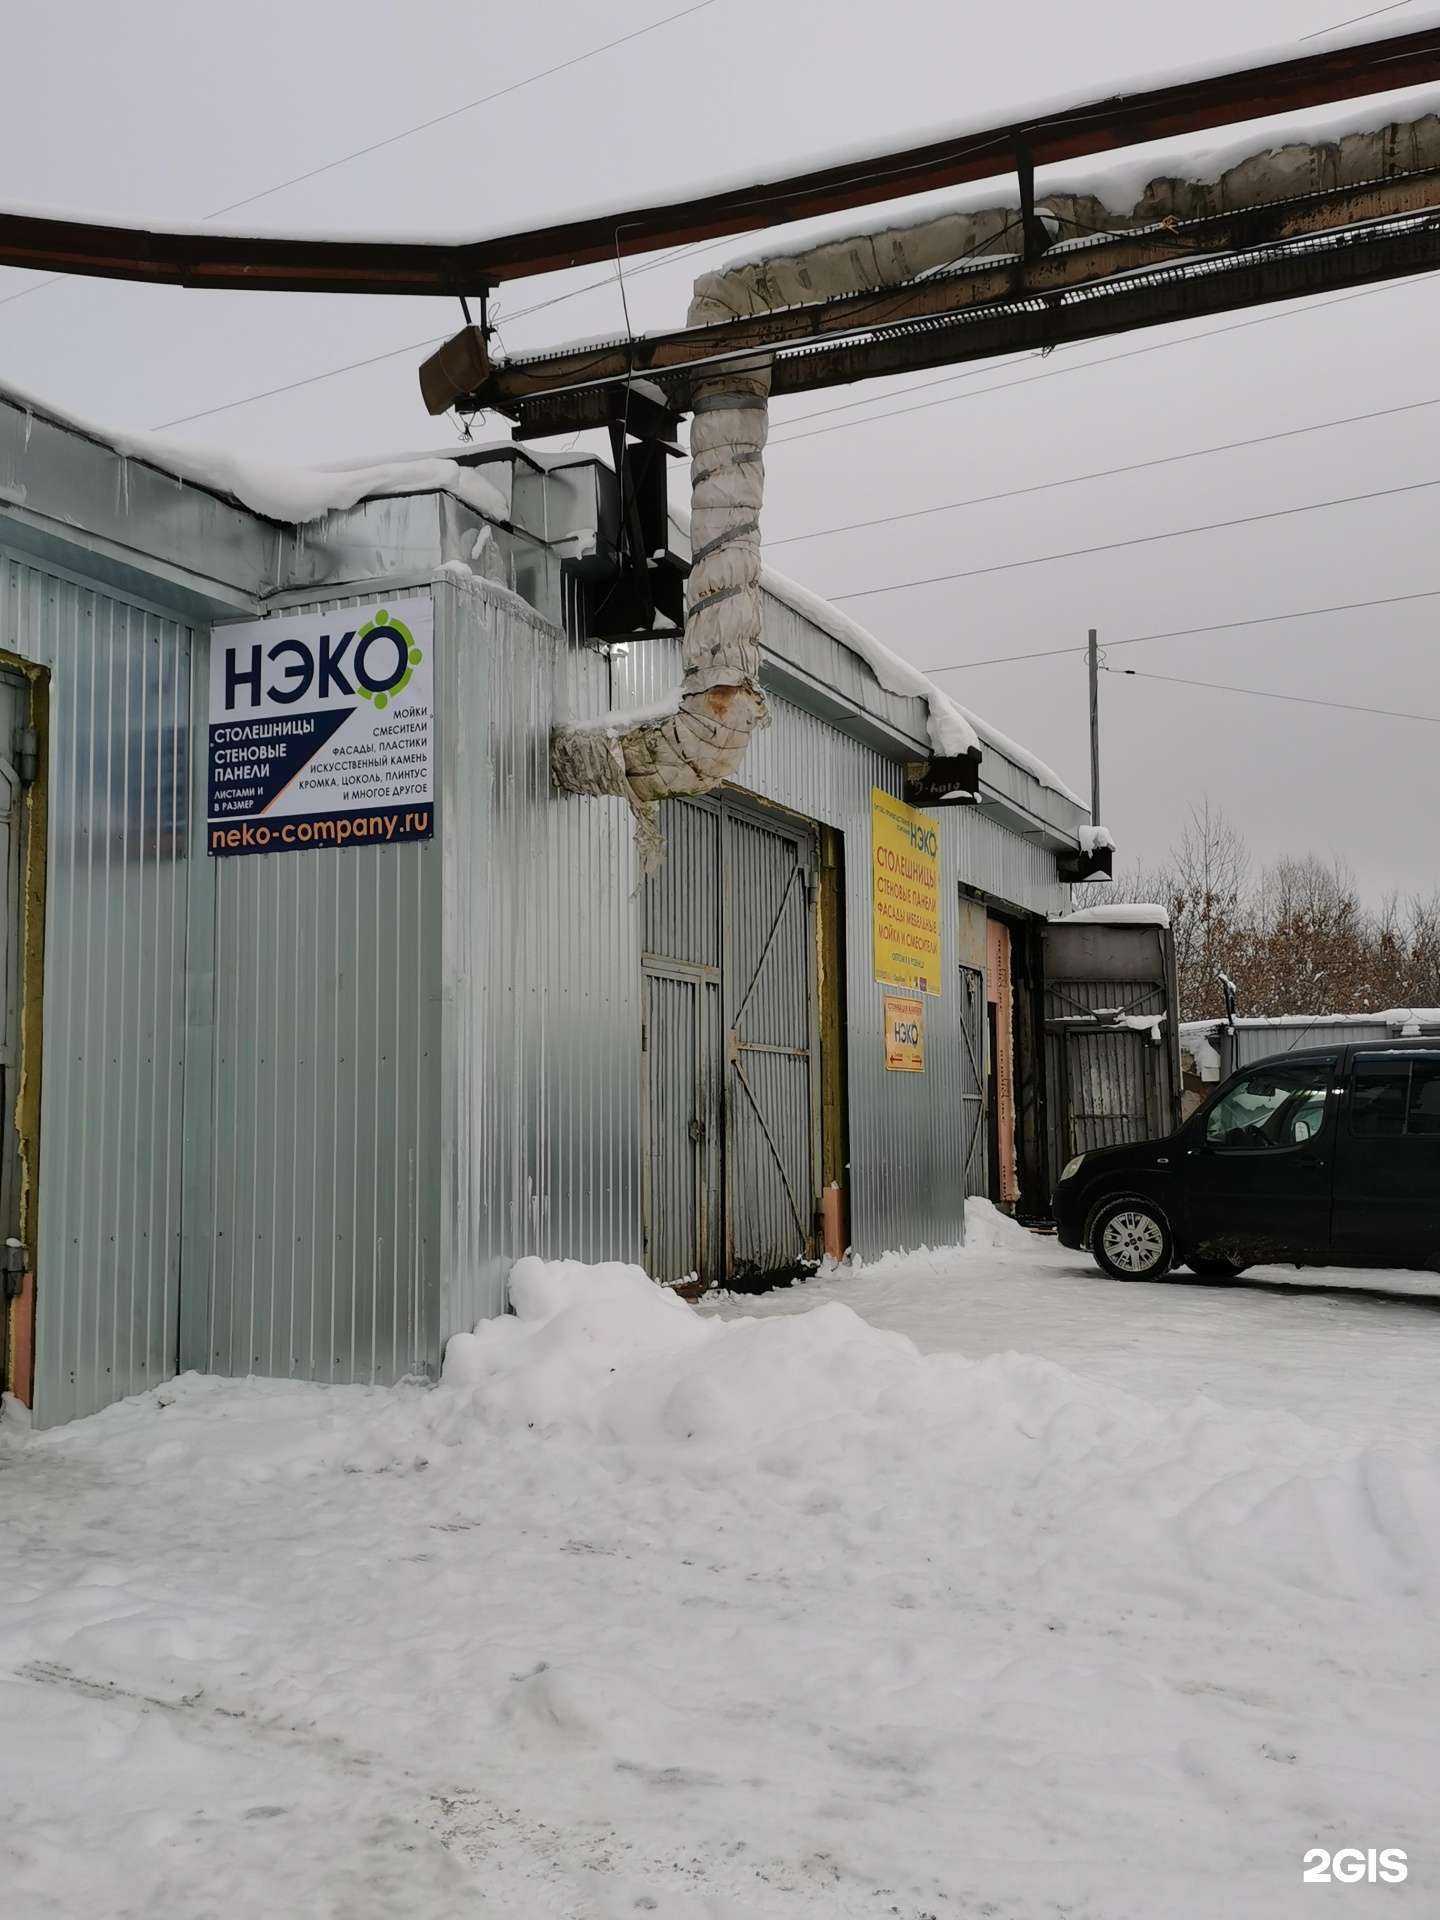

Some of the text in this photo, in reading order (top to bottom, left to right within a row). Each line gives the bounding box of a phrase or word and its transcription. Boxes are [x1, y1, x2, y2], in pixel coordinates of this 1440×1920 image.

[225, 625, 409, 710] НЭКО
[393, 707, 427, 719] МОЙКИ
[214, 718, 315, 743] СТОЛЕШНИЦЫ
[372, 722, 427, 737] СМЕСИТЕЛИ
[214, 743, 287, 764] СТЕНОВЫЕ
[332, 738, 427, 757] ФАСАДЫ, ПЛАСТИКИ
[214, 763, 270, 782] ПАНЕЛИ
[310, 753, 428, 774] ИСКУССТВЕННЫЙ КАМЕНЬ
[341, 773, 383, 787] ЦОКОЛЬ,
[385, 768, 428, 781] ПЛИНТУС
[214, 786, 264, 800] ЛИСТАМИ И
[343, 783, 428, 800] И МНОГОЕ ДРУГОЕ
[214, 800, 254, 812] В РАЗМЕР
[211, 812, 429, 849] neko-company.ru
[910, 822, 937, 858] НЭКО
[877, 846, 937, 890] СТОЛЕШНИЦЫ
[877, 876, 937, 912] СТЕНОВЫЕ ПАНЕЛИ
[894, 1021, 919, 1046] НЭКО
